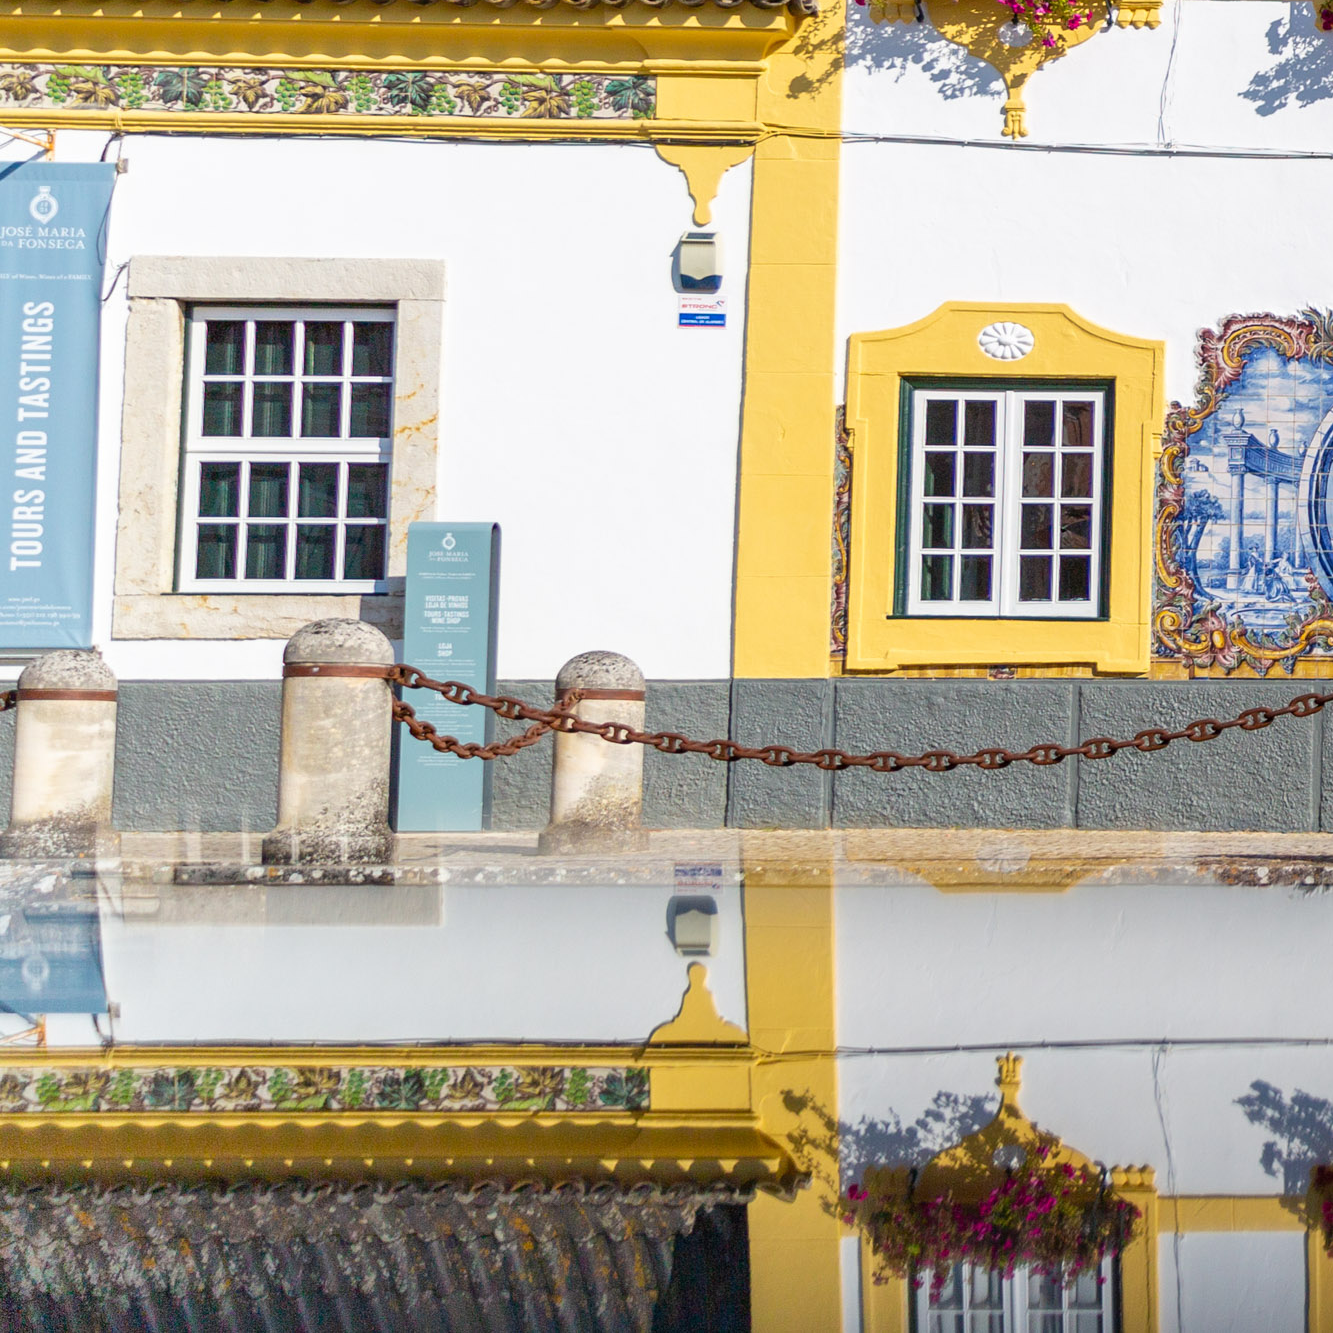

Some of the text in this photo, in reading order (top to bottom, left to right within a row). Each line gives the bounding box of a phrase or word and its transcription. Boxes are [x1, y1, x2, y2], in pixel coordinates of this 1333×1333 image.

[0, 225, 86, 238] JOSÉ MARIA
[18, 238, 86, 250] FONSECA
[18, 301, 54, 422] TASTINGS
[14, 430, 48, 481] AND
[10, 489, 46, 571] TOURS
